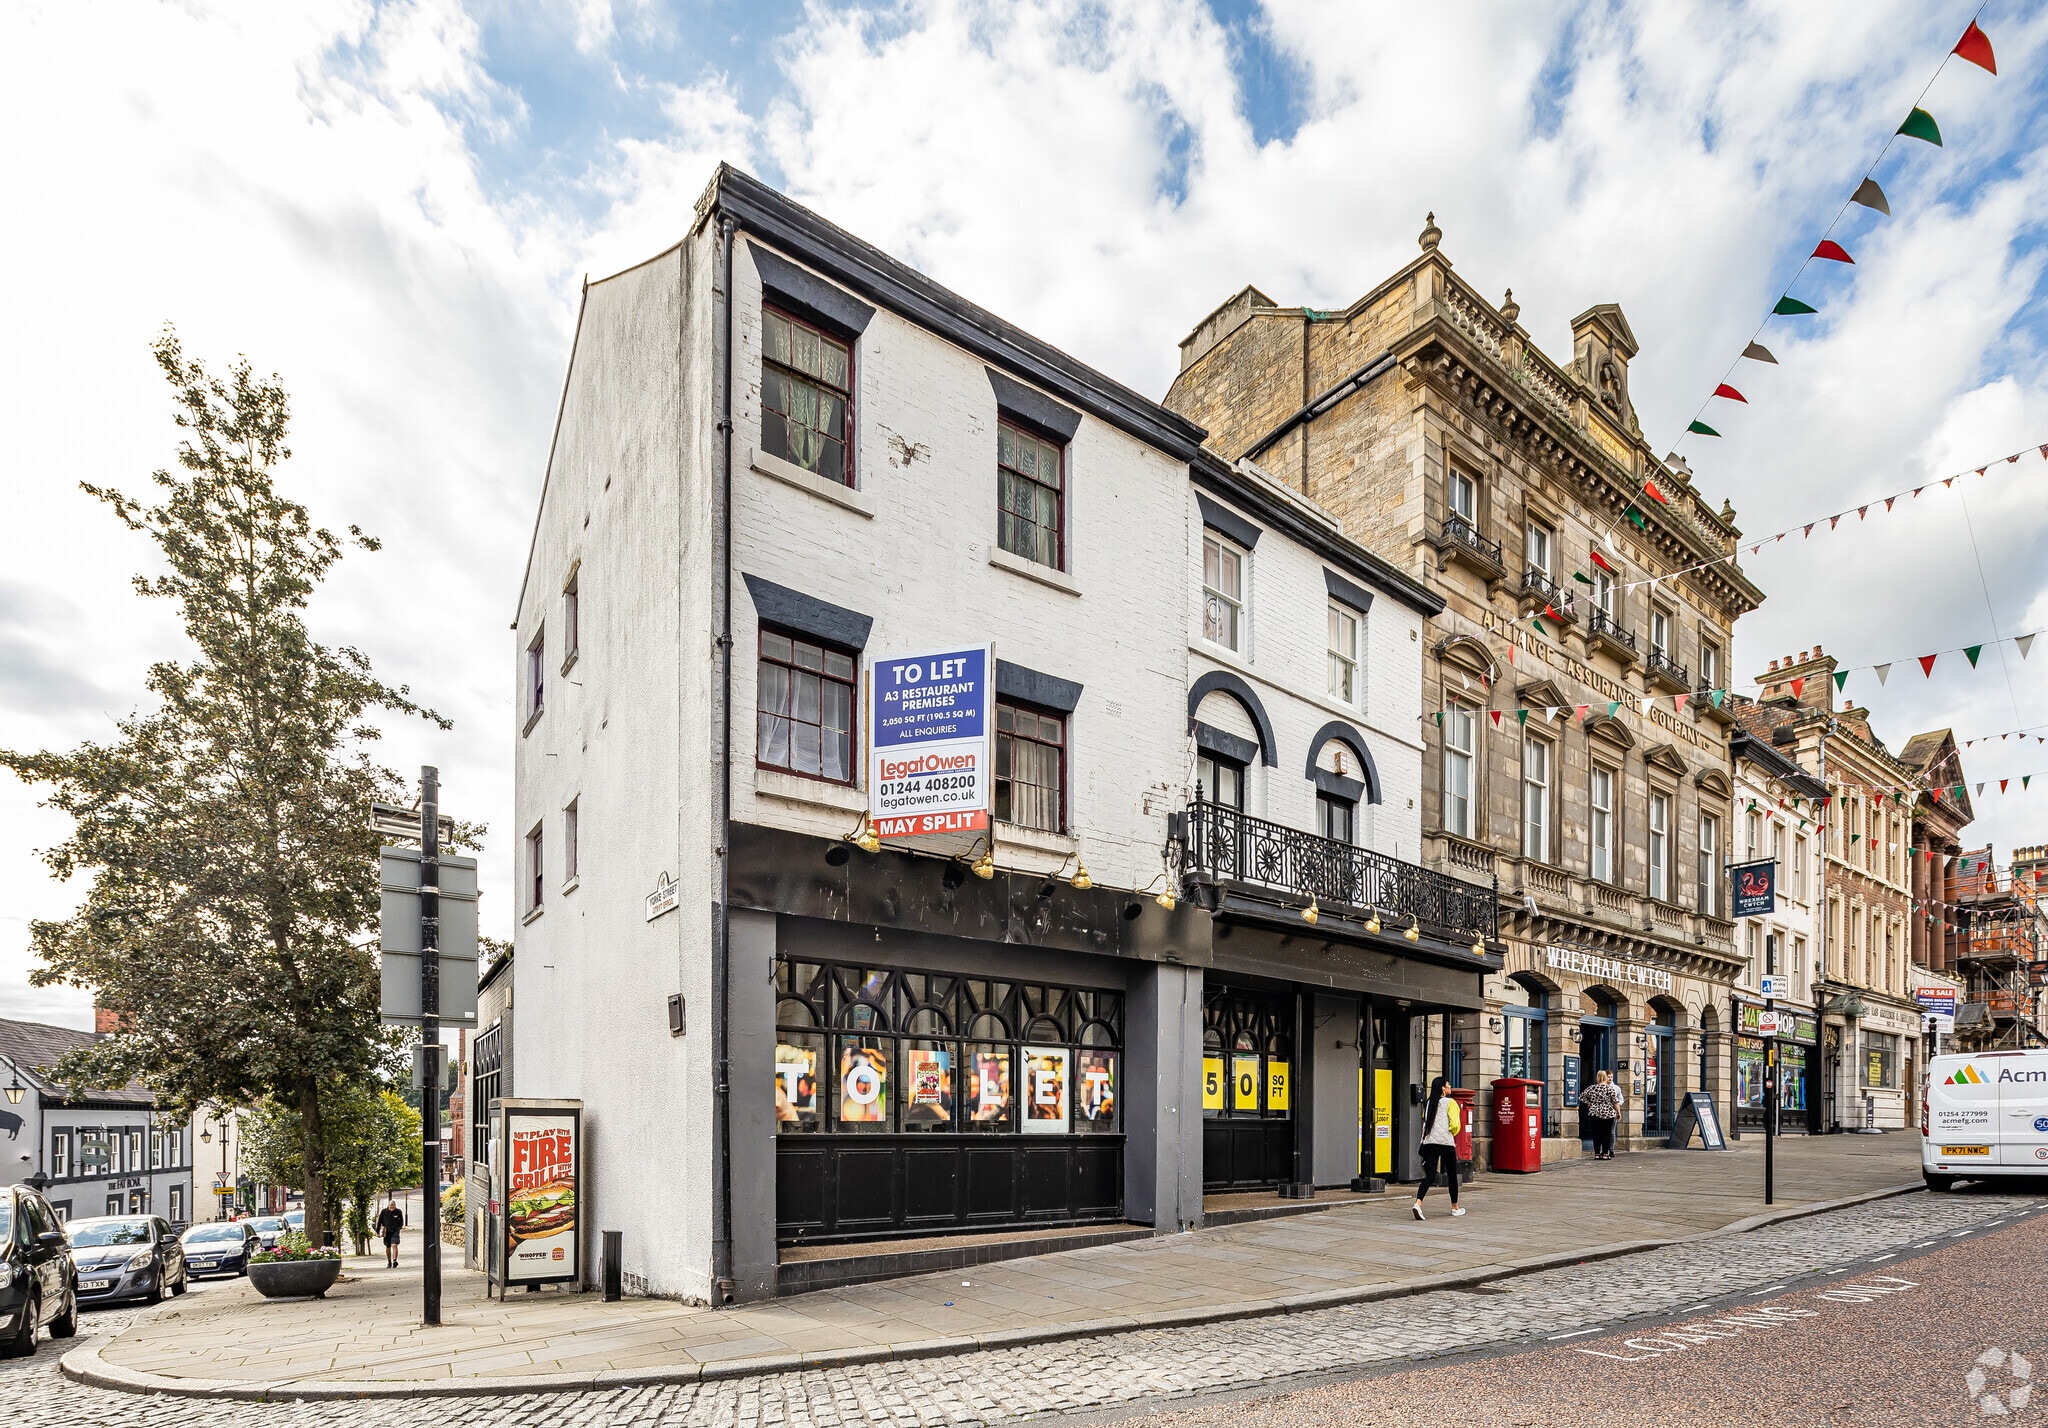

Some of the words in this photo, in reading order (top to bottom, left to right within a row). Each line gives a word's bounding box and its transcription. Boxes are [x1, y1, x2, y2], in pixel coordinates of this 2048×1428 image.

[892, 663, 922, 685] TO
[930, 658, 967, 681] LET
[1483, 610, 1555, 664] ALLIANCE
[1567, 659, 1642, 714] ASSURANCE
[1651, 707, 1702, 746] COMPANY
[884, 691, 899, 702] A3
[902, 682, 975, 700] RESTAURANT
[902, 695, 955, 711] PREMISES
[882, 717, 902, 727] 2,050
[904, 715, 915, 724] SQ
[916, 714, 926, 722] FT
[926, 711, 951, 723] (190.5
[952, 710, 963, 719] SQ
[965, 708, 976, 718] M)
[899, 730, 912, 739] ALL
[914, 724, 957, 737] ENQUIRIES
[880, 779, 921, 796] 01244
[925, 774, 975, 792] 408200
[880, 789, 975, 809] legatowen.co.uk
[879, 817, 917, 836] MAY
[922, 812, 975, 831] SPLIT
[663, 883, 678, 899] STREET
[1546, 945, 1621, 980] WREXHAM
[1627, 963, 1671, 990] CWTCH
[1272, 1075, 1284, 1086] SQ
[1272, 1087, 1283, 1098] FT
[529, 1128, 556, 1140] PLAY
[557, 1128, 571, 1136] WITH
[513, 1135, 572, 1174] FIRE
[558, 1163, 572, 1171] WITH
[513, 1166, 558, 1189] GRILL
[90, 1280, 106, 1288] TXK
[1816, 1275, 1922, 1303] ONLY
